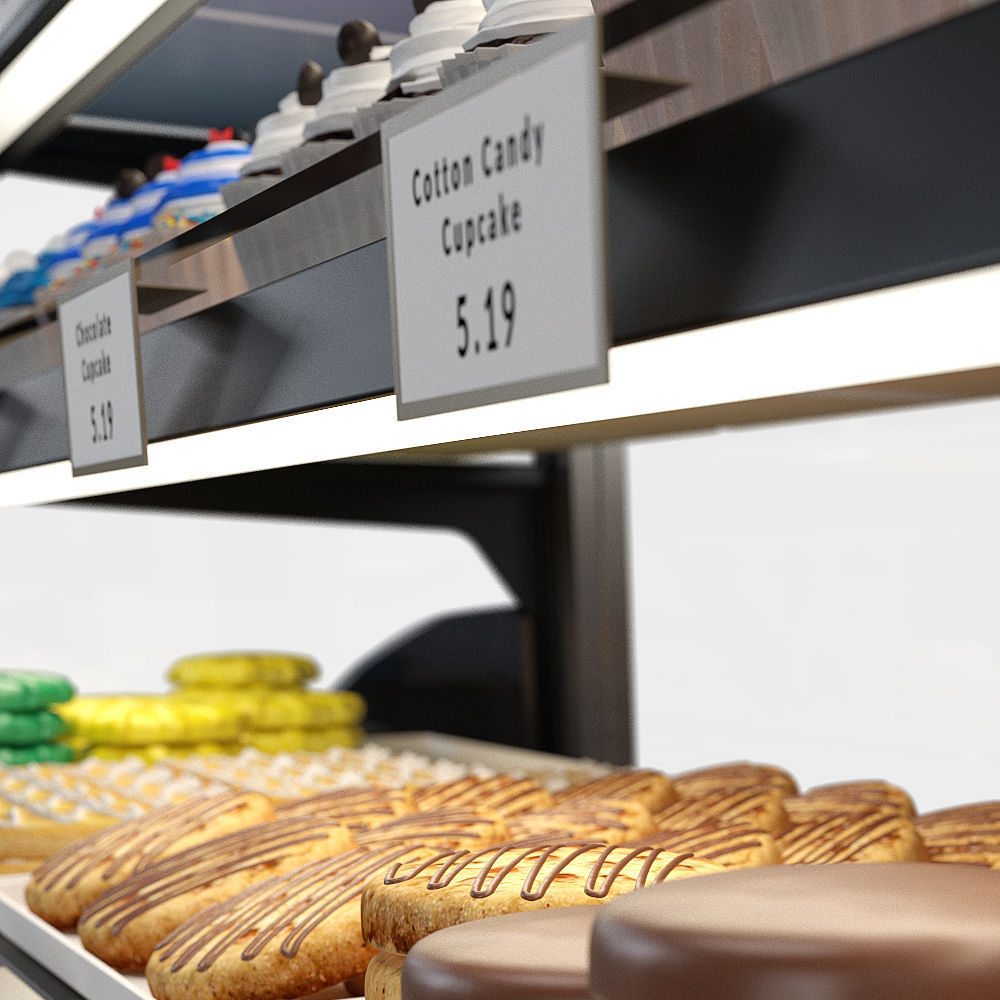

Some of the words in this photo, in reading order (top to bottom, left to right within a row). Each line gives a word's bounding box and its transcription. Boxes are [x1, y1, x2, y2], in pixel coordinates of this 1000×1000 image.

[412, 153, 473, 206] Cotton
[481, 114, 545, 178] Candy
[440, 192, 523, 257] Cupcake
[75, 312, 112, 348] Chocolate
[457, 280, 516, 358] 5.19
[81, 350, 112, 383] Cupcake
[90, 399, 114, 444] 5.19
